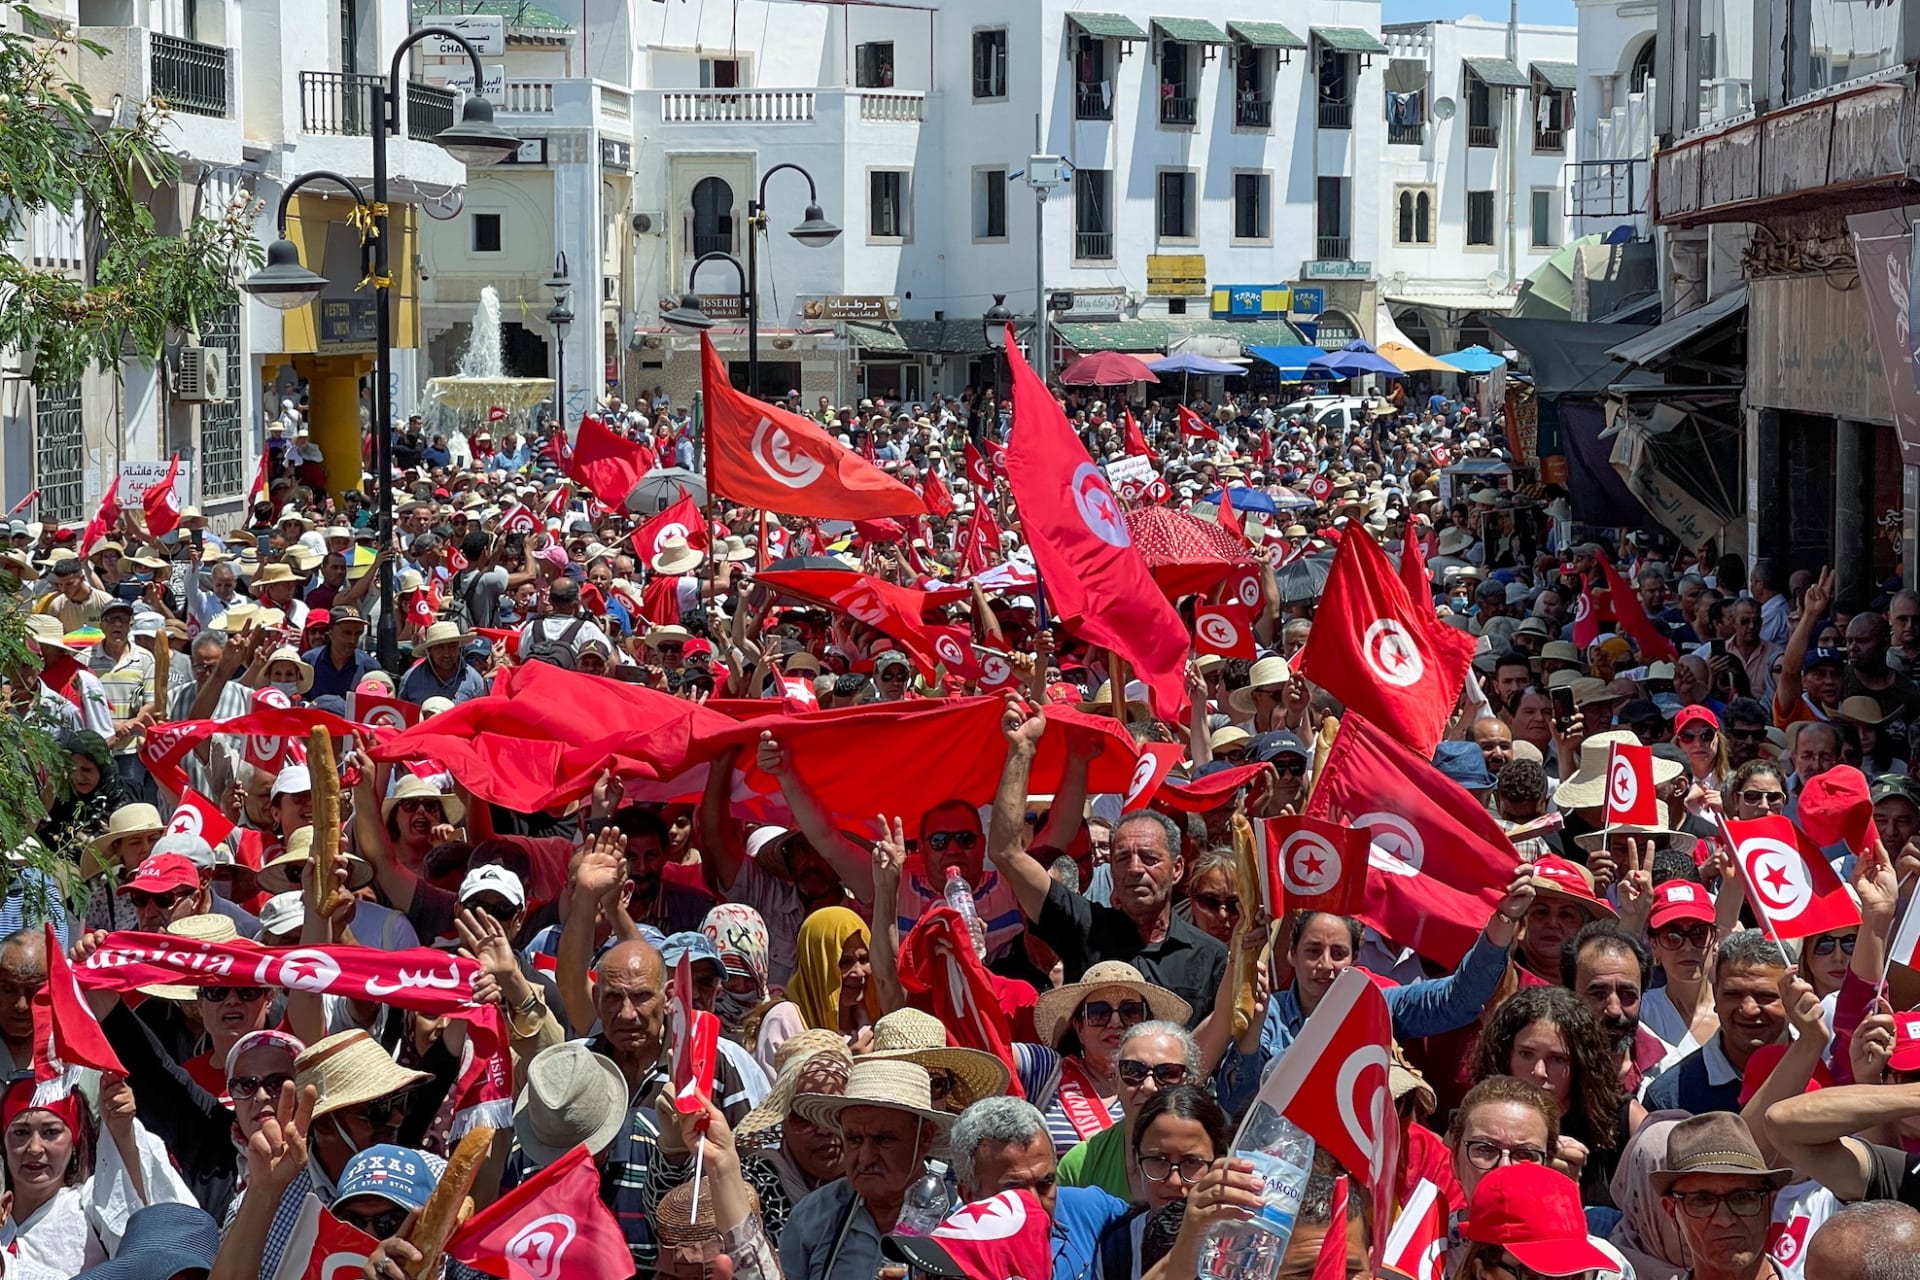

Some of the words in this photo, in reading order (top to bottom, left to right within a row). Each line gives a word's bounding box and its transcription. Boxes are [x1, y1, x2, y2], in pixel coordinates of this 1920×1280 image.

[440, 45, 485, 53] CHAE
[702, 298, 739, 308] ISSERIE
[828, 299, 881, 311] مرطبات
[324, 303, 350, 317] WESTERN
[333, 321, 350, 336] UNION
[1316, 328, 1353, 338] ISINE
[123, 464, 152, 476] فاشلة
[154, 466, 186, 477] حومة
[124, 494, 144, 505] رحل
[147, 725, 198, 763] nisia
[86, 942, 236, 976] unisia
[488, 1050, 506, 1088] isie
[1060, 1081, 1104, 1140] TUNISI
[347, 1156, 416, 1180] TEXAS
